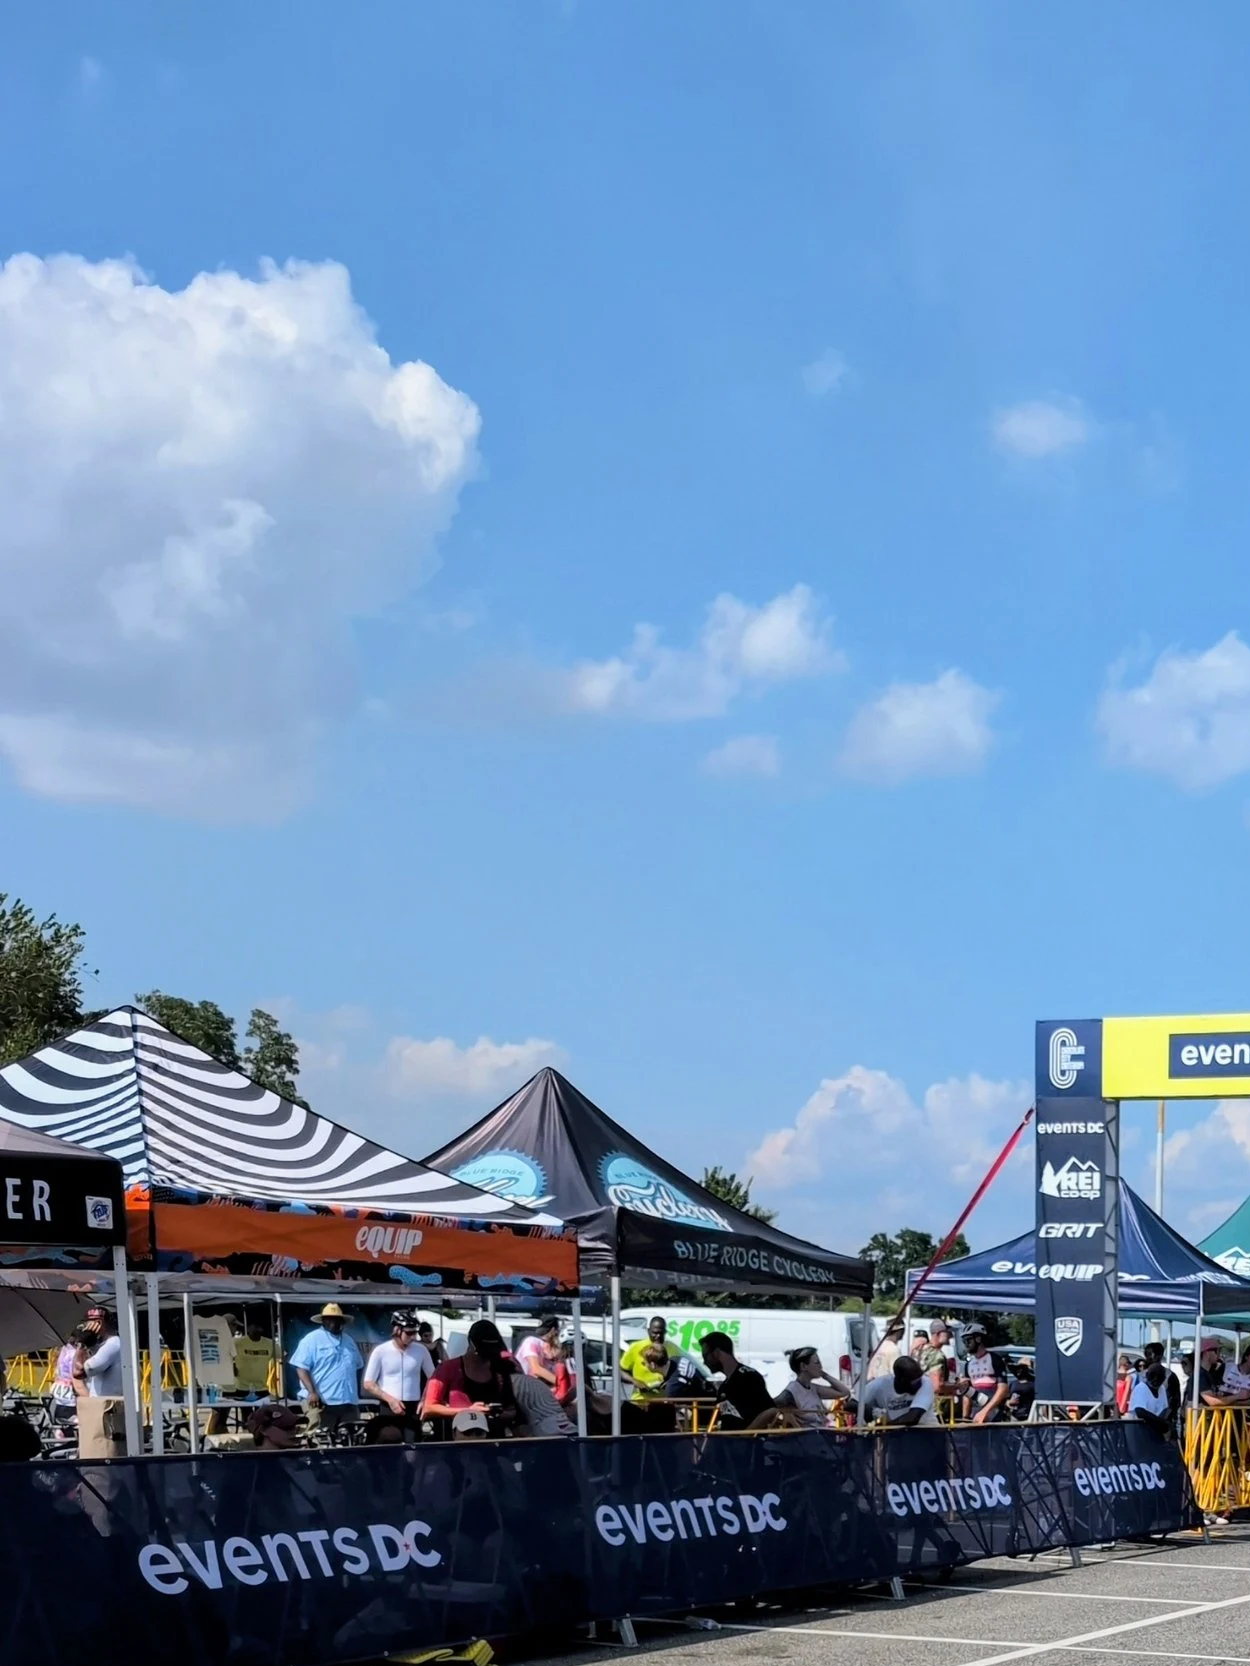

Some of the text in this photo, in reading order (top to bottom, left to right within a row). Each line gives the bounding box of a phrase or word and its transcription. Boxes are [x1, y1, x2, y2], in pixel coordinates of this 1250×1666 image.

[1037, 1122, 1104, 1134] events DC
[1060, 1171, 1101, 1190] REI
[1038, 1222, 1104, 1238] GRIT
[673, 1240, 836, 1284] BLUE RIDGE CYCLERY
[1057, 1319, 1079, 1328] USA
[886, 1473, 1013, 1517] events DC
[1073, 1461, 1167, 1497] events DC
[595, 1491, 788, 1547] events DC
[138, 1519, 442, 1596] events DC
